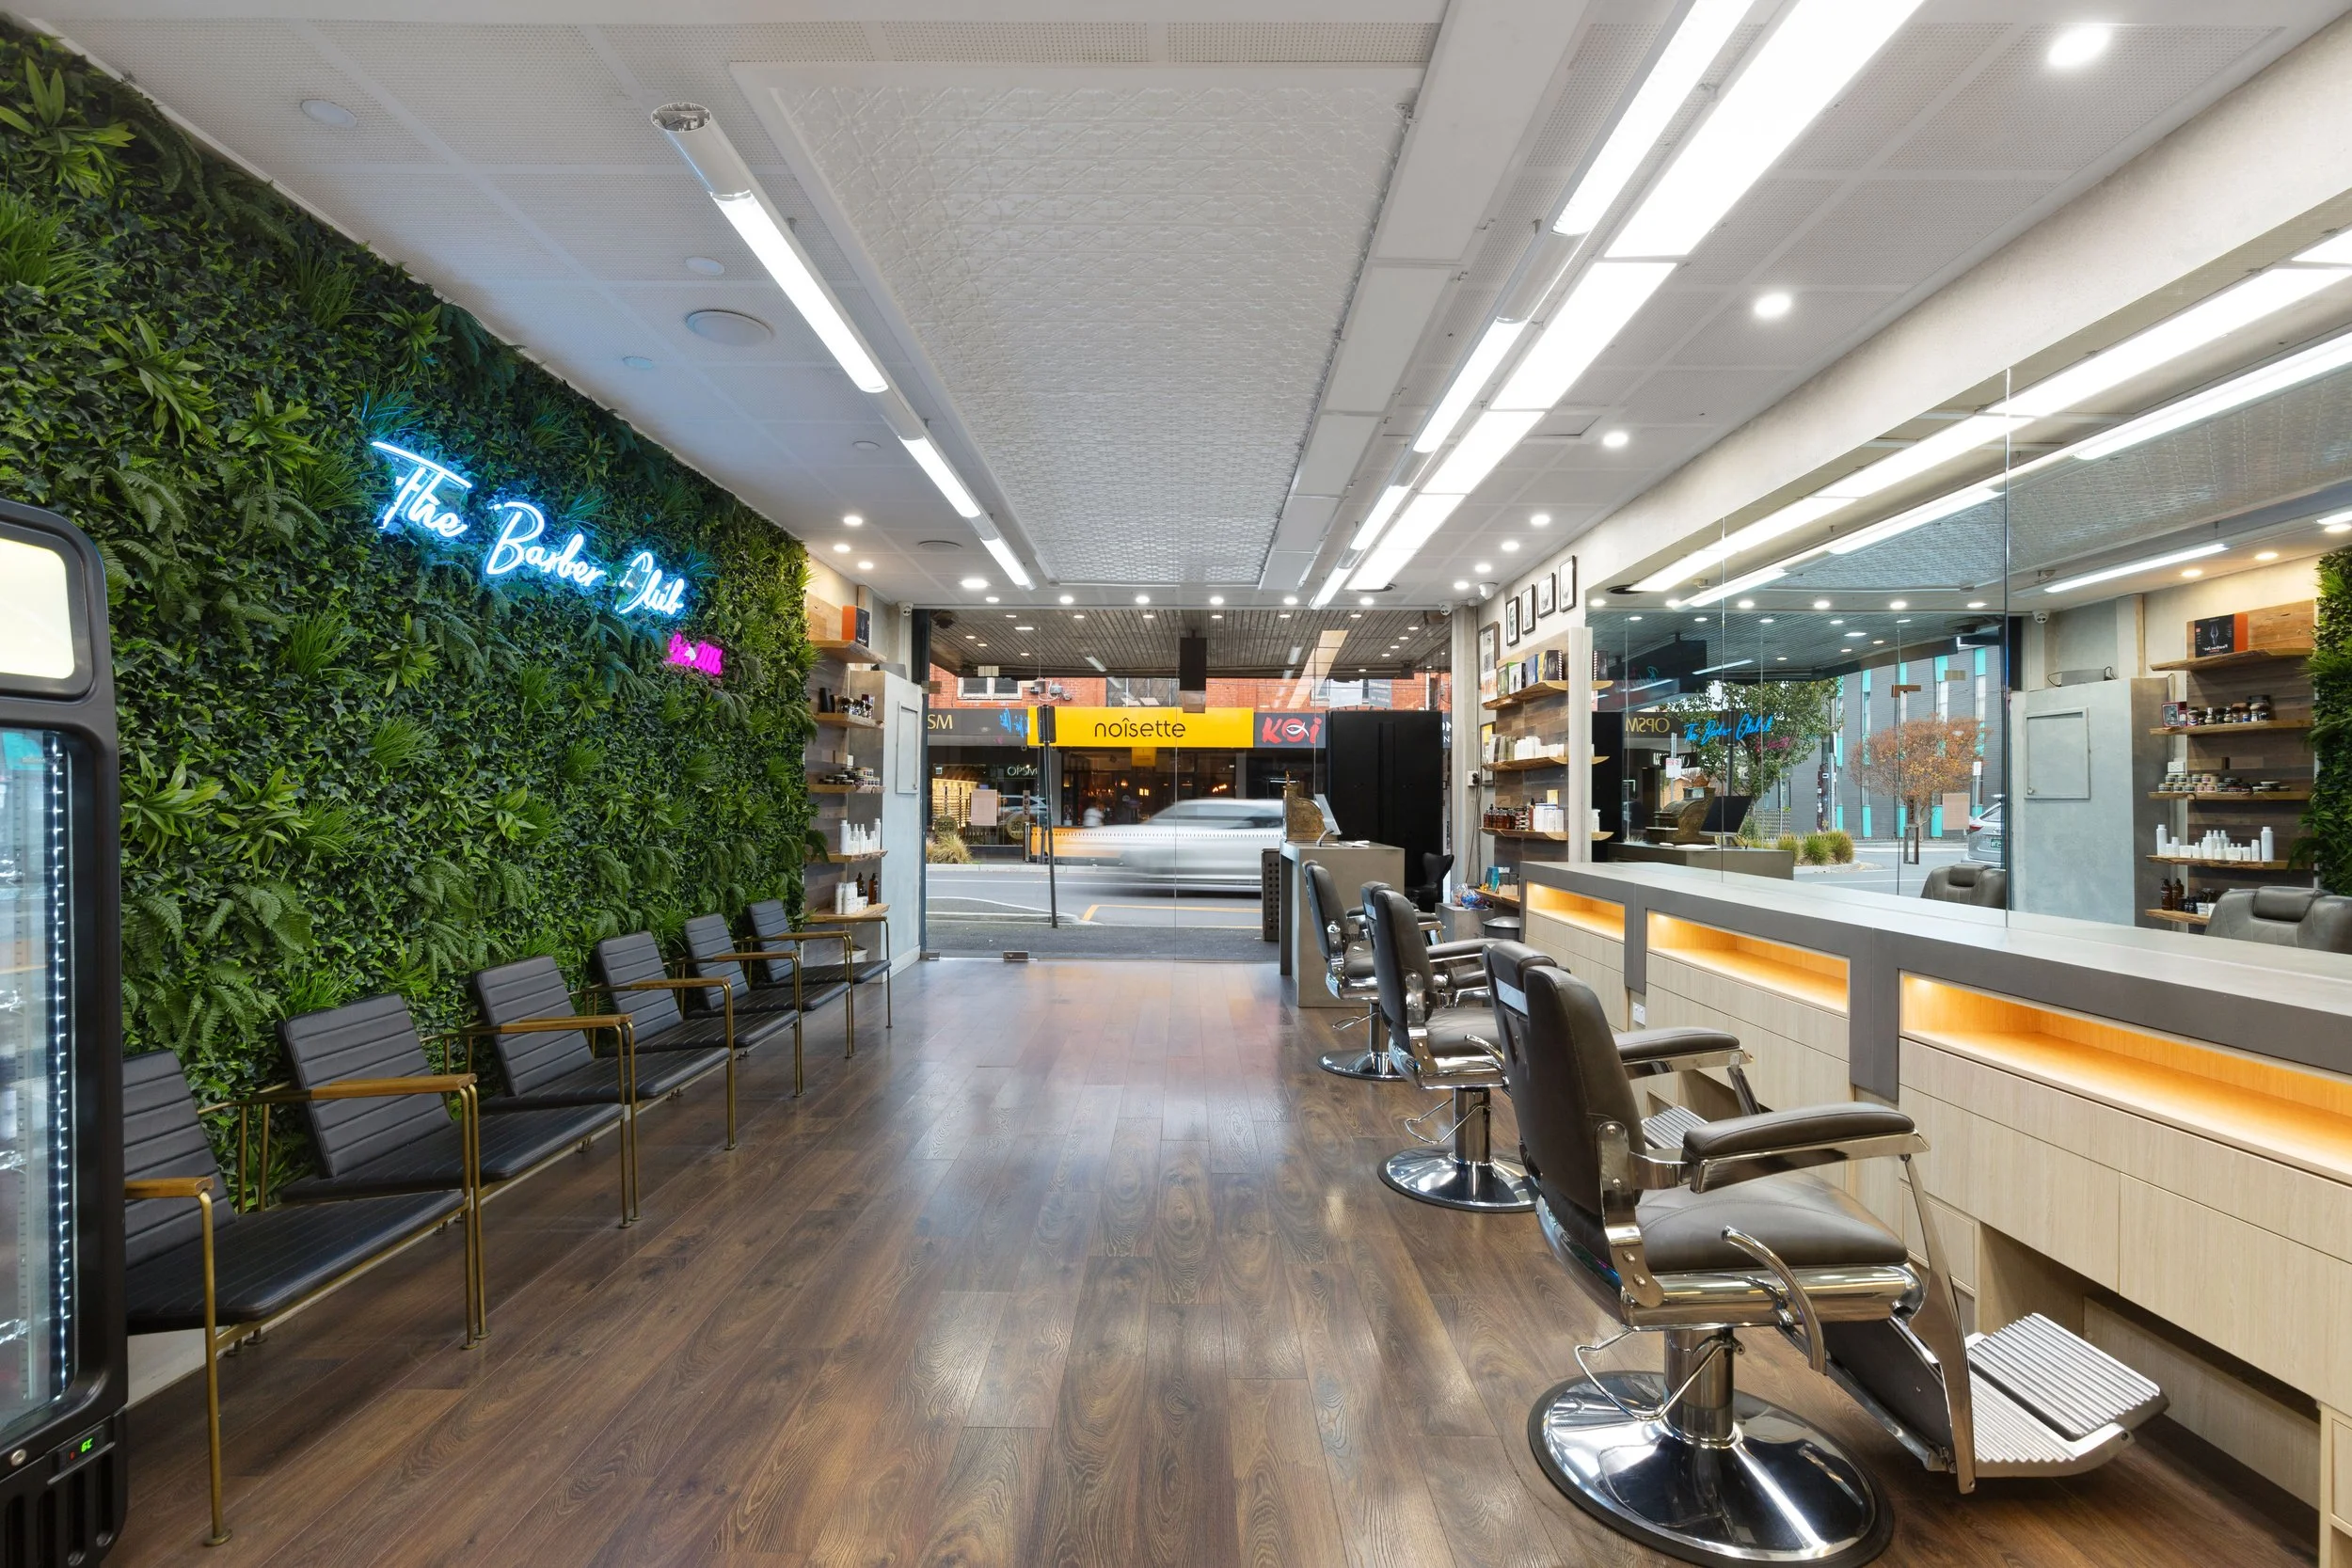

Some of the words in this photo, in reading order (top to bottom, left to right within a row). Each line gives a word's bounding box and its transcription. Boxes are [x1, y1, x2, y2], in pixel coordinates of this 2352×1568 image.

[372, 441, 472, 537] The
[486, 501, 607, 586] Barber
[615, 551, 685, 615] Club
[1094, 718, 1186, 738] noîsette
